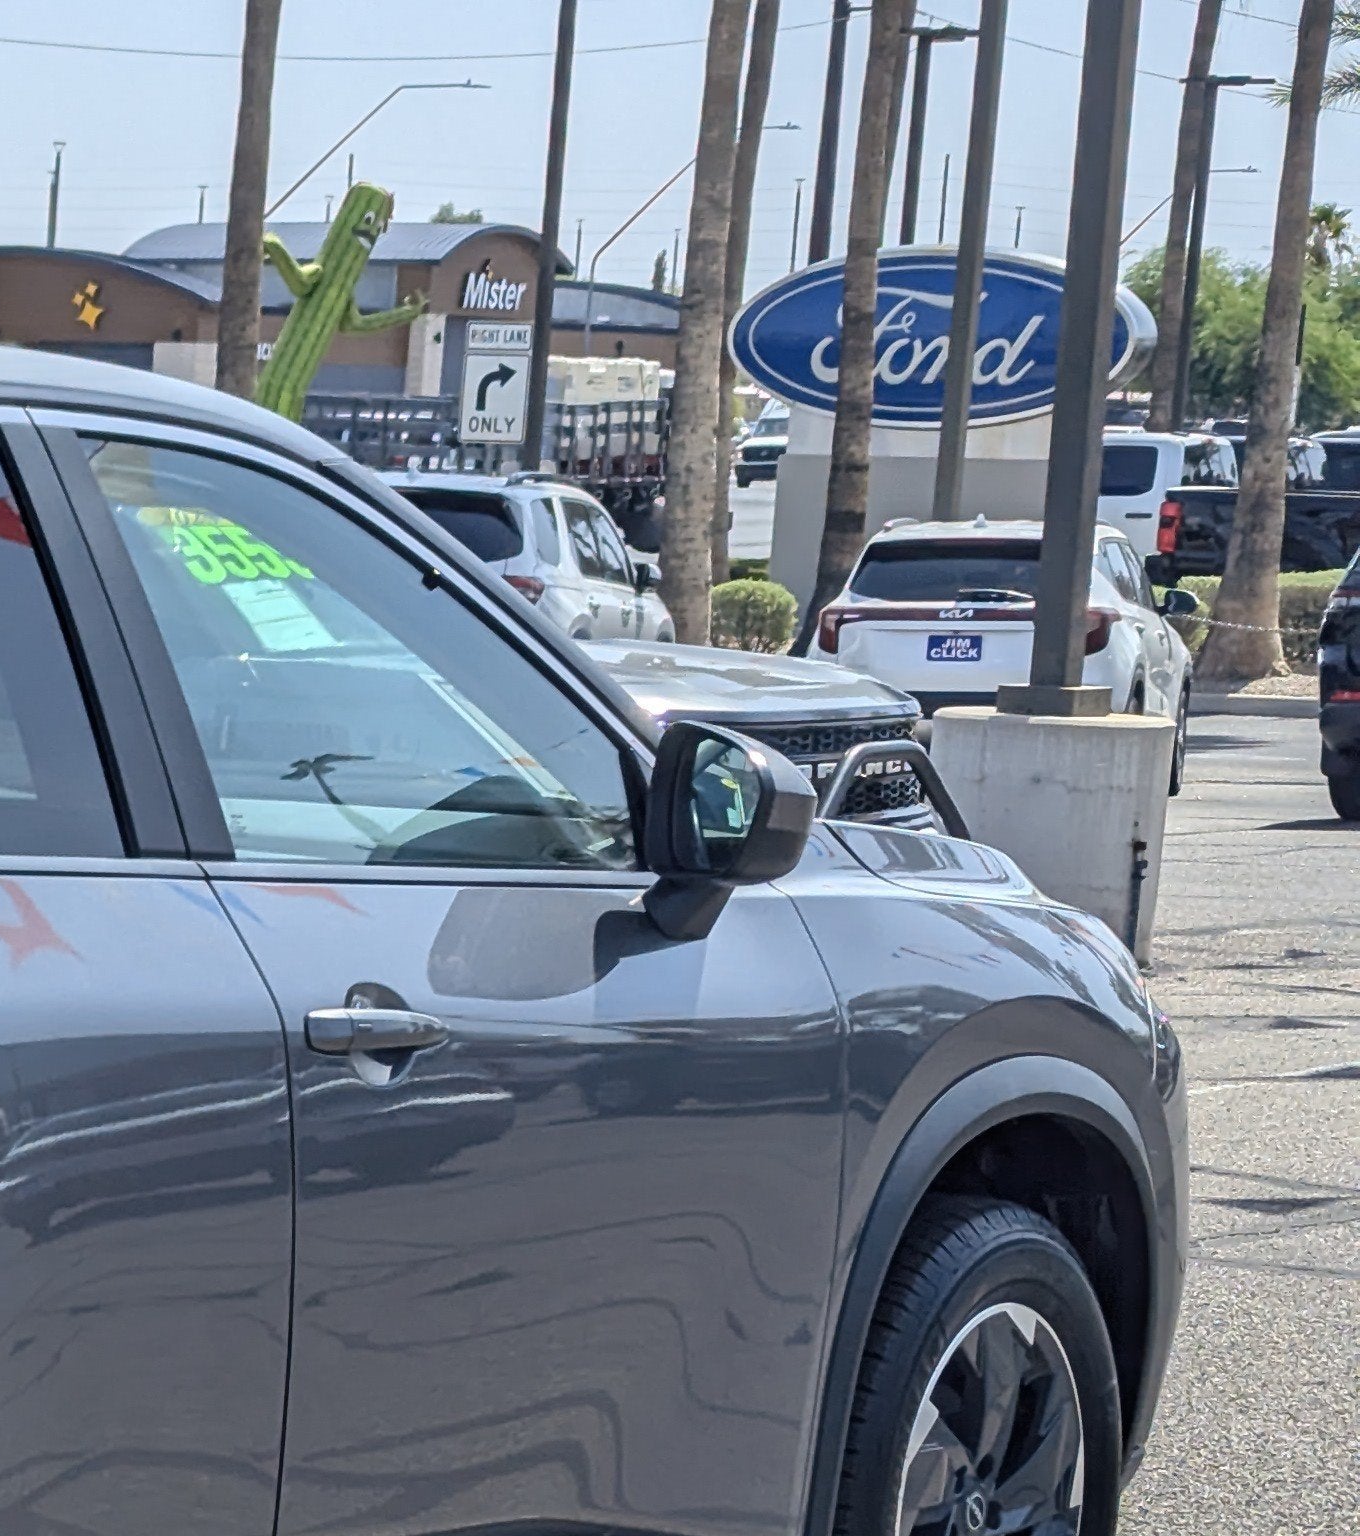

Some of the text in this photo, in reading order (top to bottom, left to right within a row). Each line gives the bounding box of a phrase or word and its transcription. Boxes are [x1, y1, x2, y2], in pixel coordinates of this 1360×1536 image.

[462, 271, 527, 310] Mister
[503, 328, 528, 344] LANE
[810, 286, 1045, 385] Ford
[468, 416, 516, 434] ONLY
[941, 638, 971, 649] JIM
[930, 647, 978, 659] CLICK
